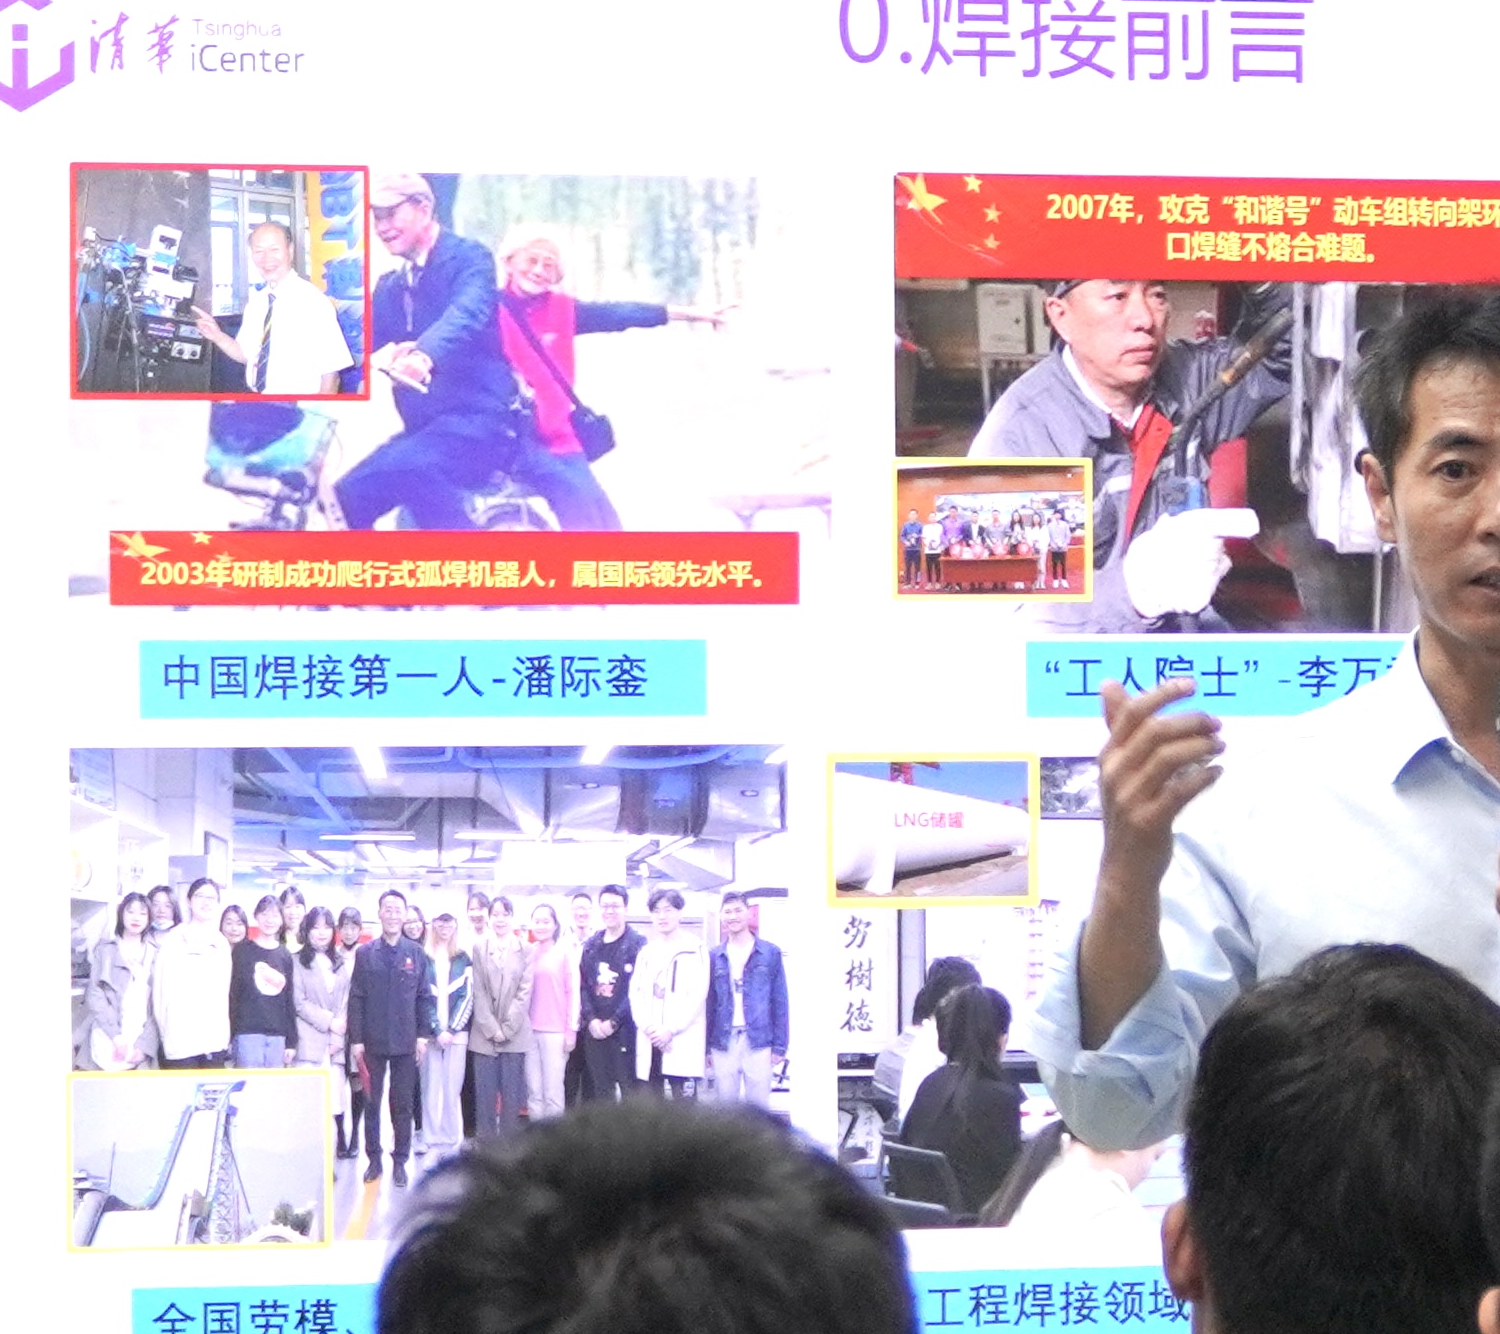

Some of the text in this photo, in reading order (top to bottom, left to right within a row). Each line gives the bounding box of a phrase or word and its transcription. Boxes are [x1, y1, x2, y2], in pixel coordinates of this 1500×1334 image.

[192, 18, 282, 40] Tsinghua
[191, 44, 304, 73] iCenter
[1166, 232, 1377, 264] 口焊缝不熔合难题。
[140, 558, 767, 590] 2003年研制成功爬行式弧焊机器人，属国际领先水平。
[162, 652, 650, 701] 中国焊接第一人-潘际銮
[924, 1279, 1191, 1329] 工程焊接领域
